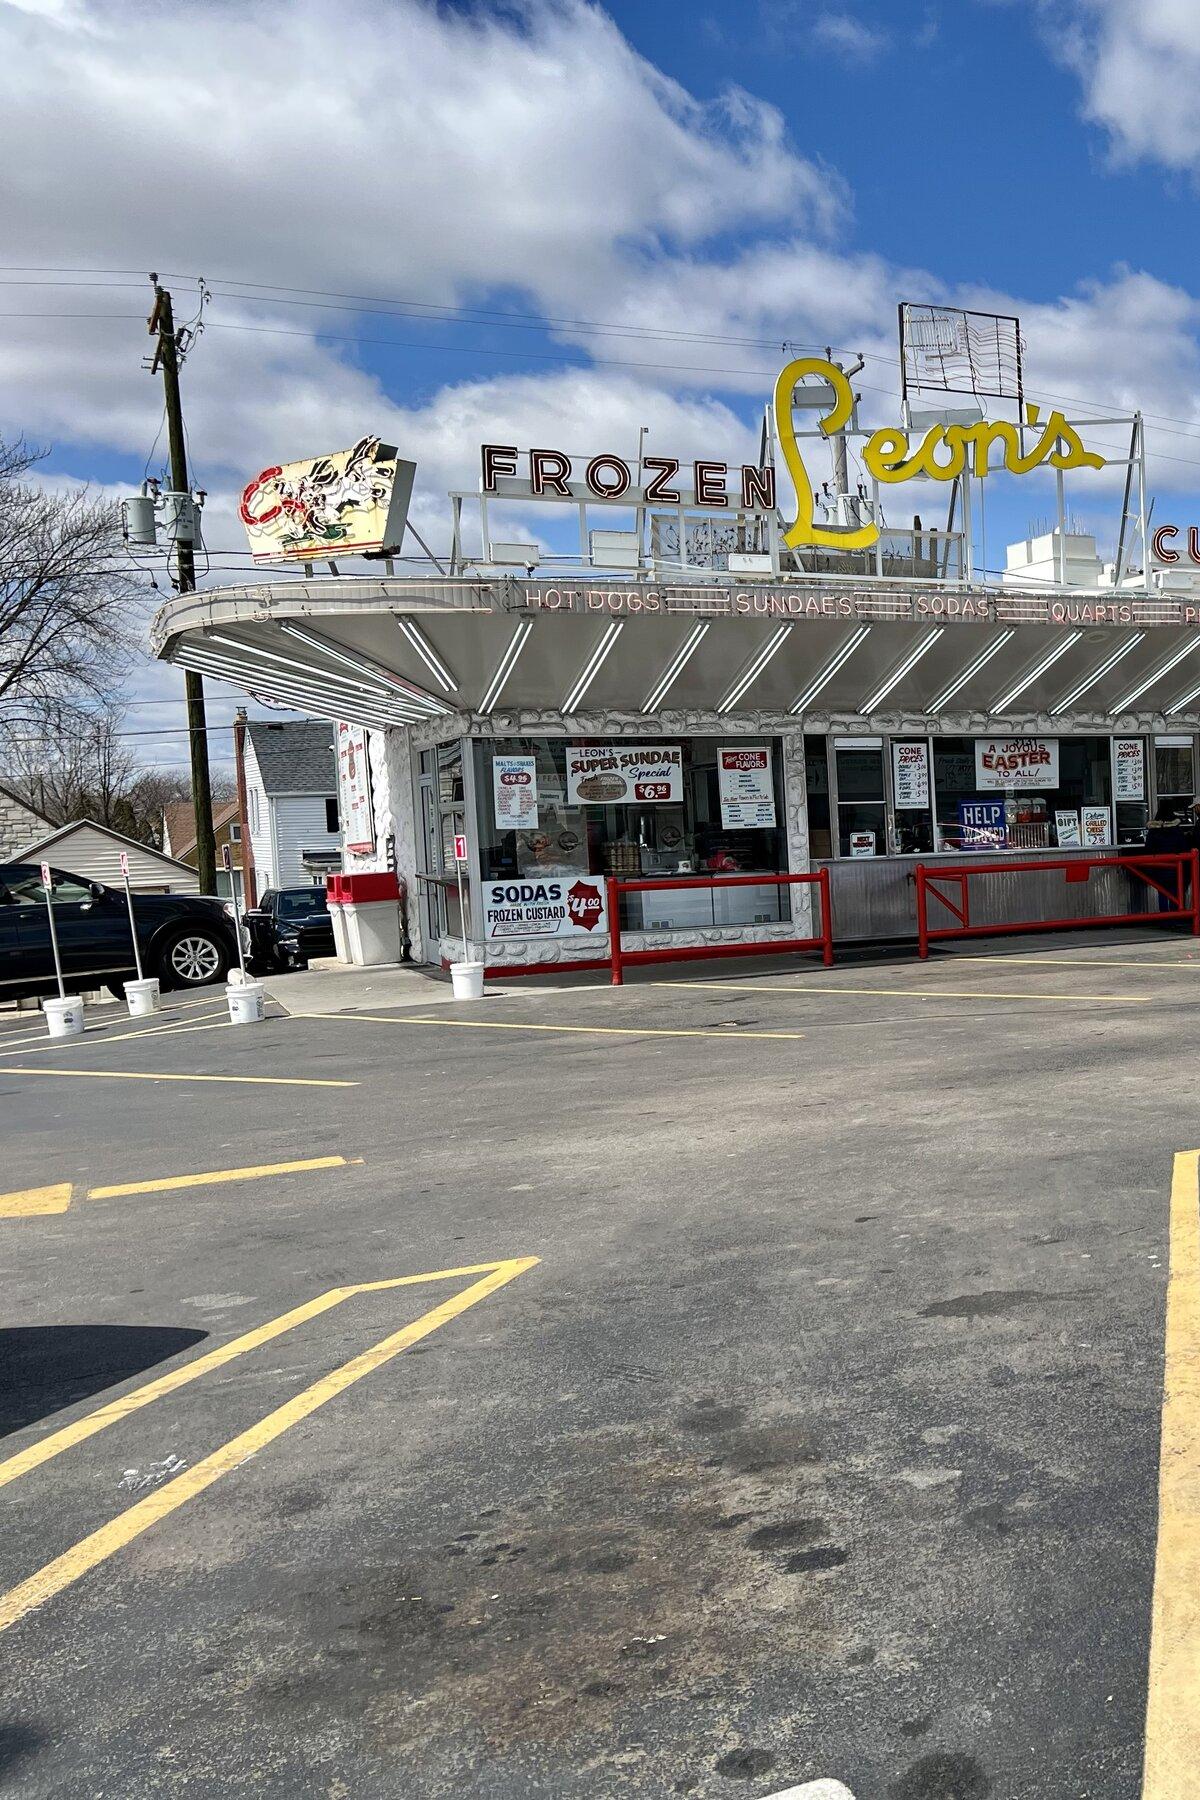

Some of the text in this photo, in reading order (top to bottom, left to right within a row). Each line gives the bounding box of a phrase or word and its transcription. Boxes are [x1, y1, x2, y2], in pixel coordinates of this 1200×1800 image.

[773, 358, 1106, 550] Leon's
[480, 444, 776, 510] FROZEN
[525, 588, 660, 611] HOT DOGS
[736, 593, 852, 615] SUNDAES
[916, 596, 990, 617] SODAS
[1052, 603, 1131, 622] QUARTS
[579, 749, 614, 758] LEON'S
[898, 747, 922, 755] CONE
[989, 744, 1046, 753] A JOYOUS
[1117, 750, 1141, 759] PRICES
[1118, 743, 1138, 751] CONE
[570, 750, 681, 777] SUPER SUNDAE
[735, 761, 765, 769] FLAVORS
[738, 753, 761, 761] CONE
[897, 755, 924, 764] PRICES
[982, 751, 1051, 770] EASTER
[627, 766, 671, 781] Special
[963, 806, 1001, 825] HELP
[456, 839, 465, 858] 1
[491, 884, 562, 904] SODAS
[487, 906, 566, 923] FROZEN CUSTARD
